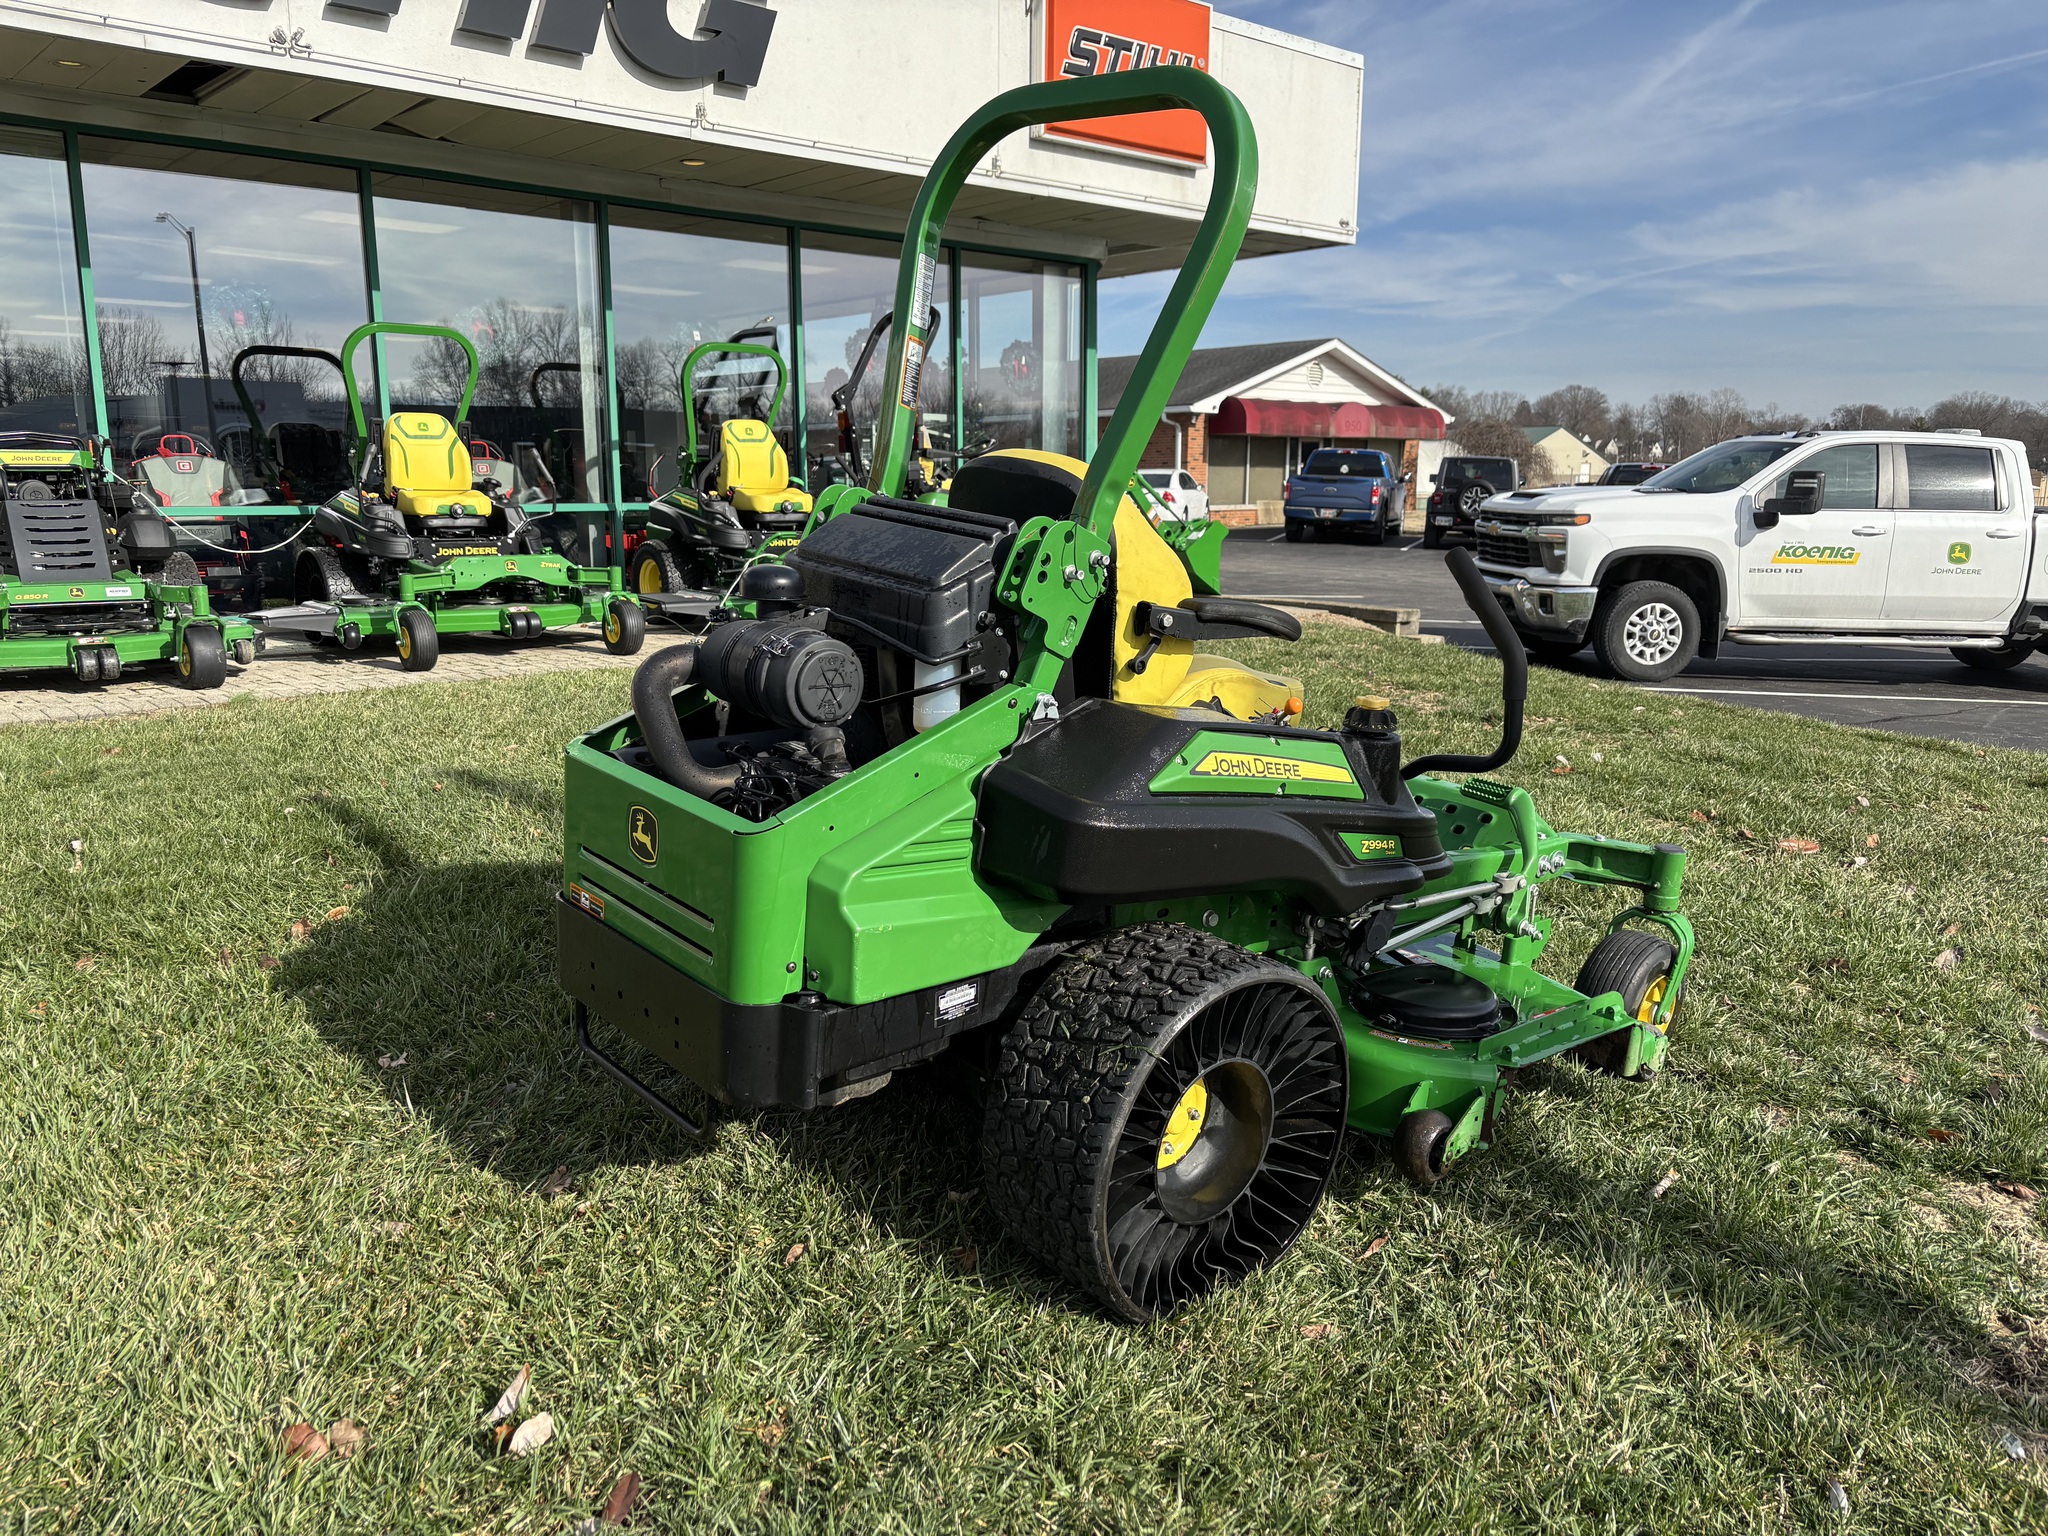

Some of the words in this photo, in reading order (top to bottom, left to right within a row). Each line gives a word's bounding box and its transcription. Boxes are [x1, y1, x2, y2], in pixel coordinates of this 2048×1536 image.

[436, 547, 464, 557] JOHN
[465, 546, 499, 556] DEERE
[540, 561, 561, 569] ZTRAK
[1931, 566, 1954, 575] JOHN
[1955, 567, 1983, 576] DEERE
[1211, 755, 1252, 774] JOHN
[1253, 757, 1302, 778] DEERE
